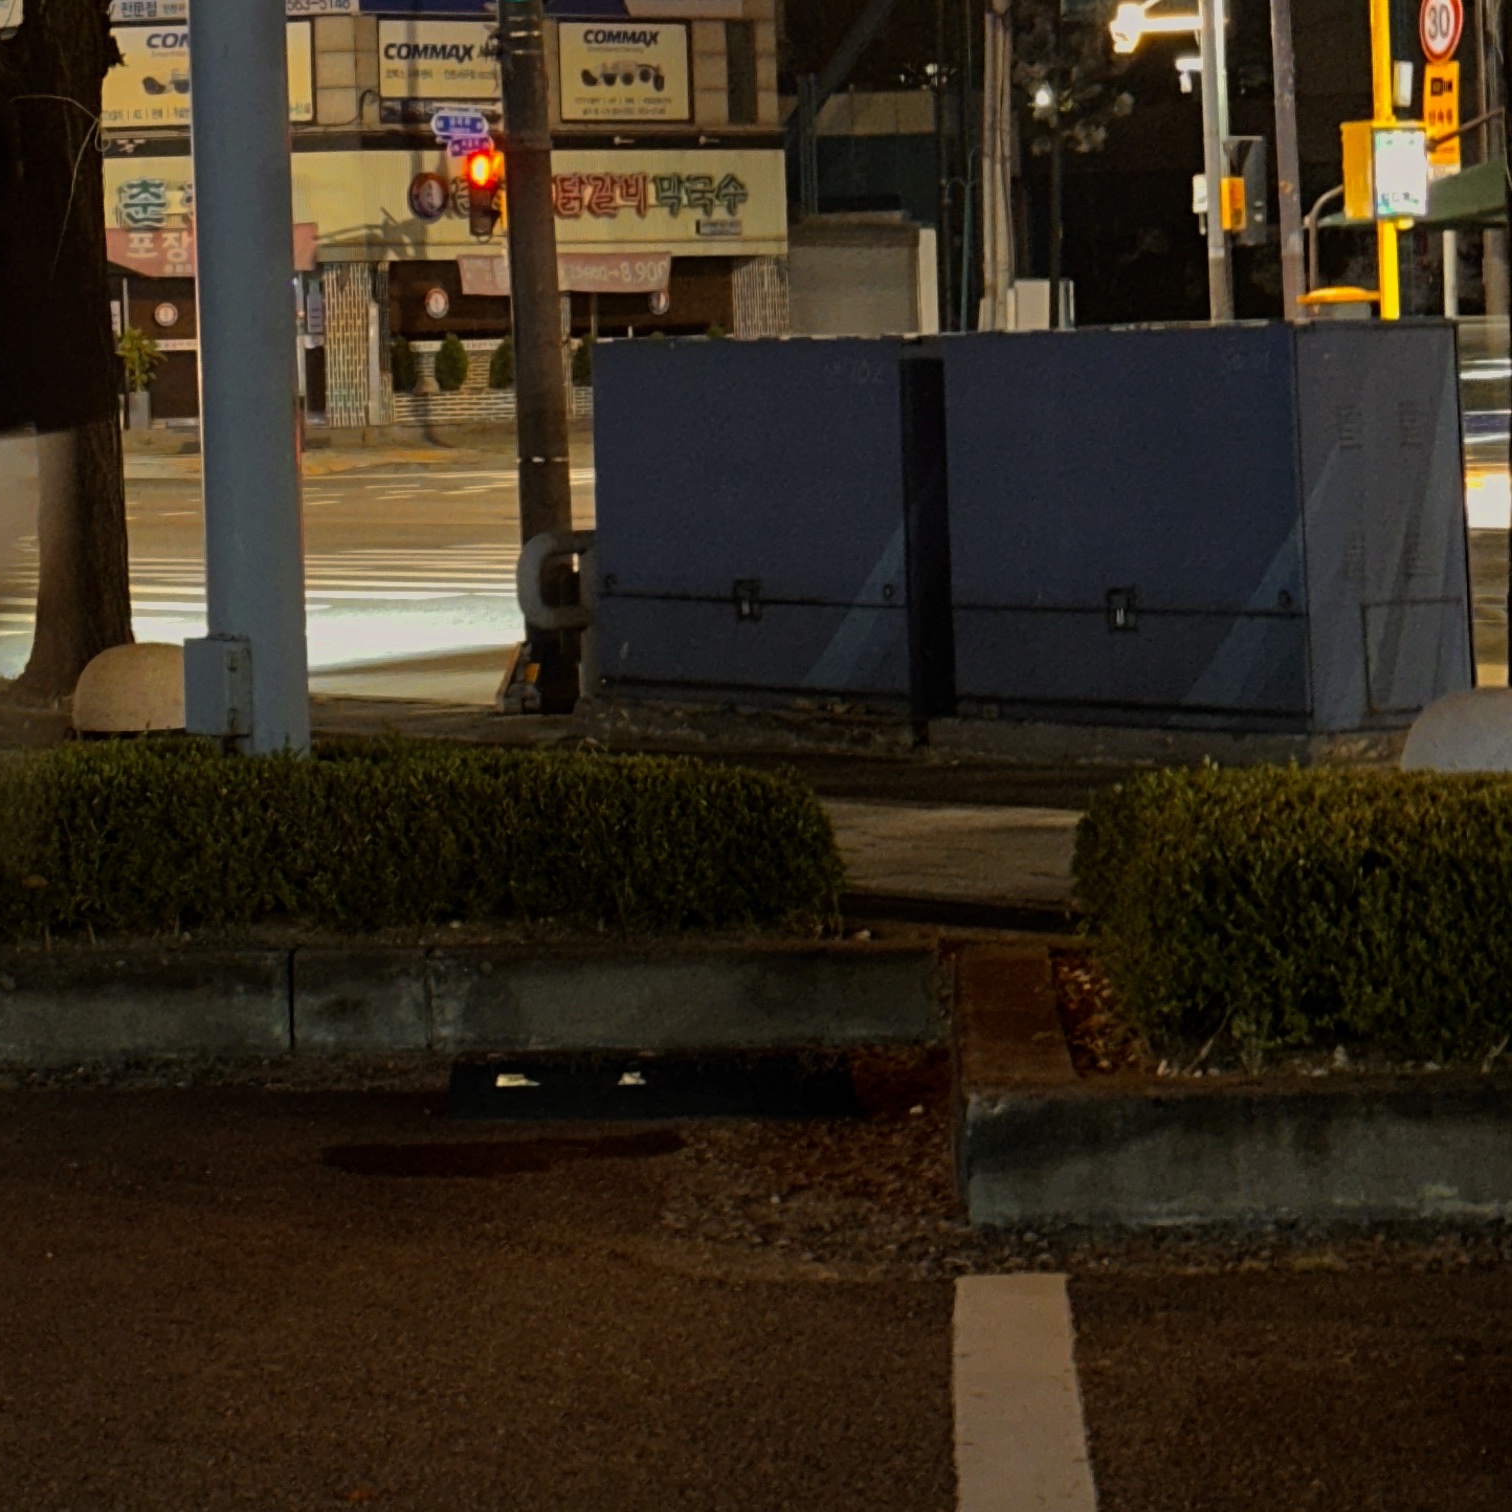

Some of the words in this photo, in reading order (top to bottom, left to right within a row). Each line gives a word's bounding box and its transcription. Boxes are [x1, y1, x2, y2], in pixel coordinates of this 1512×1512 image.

[1428, 3, 1451, 41] 30
[384, 42, 474, 63] COMMAX
[583, 29, 660, 48] COMMAX
[553, 172, 648, 218] 닭갈비
[652, 172, 750, 218] 막국수
